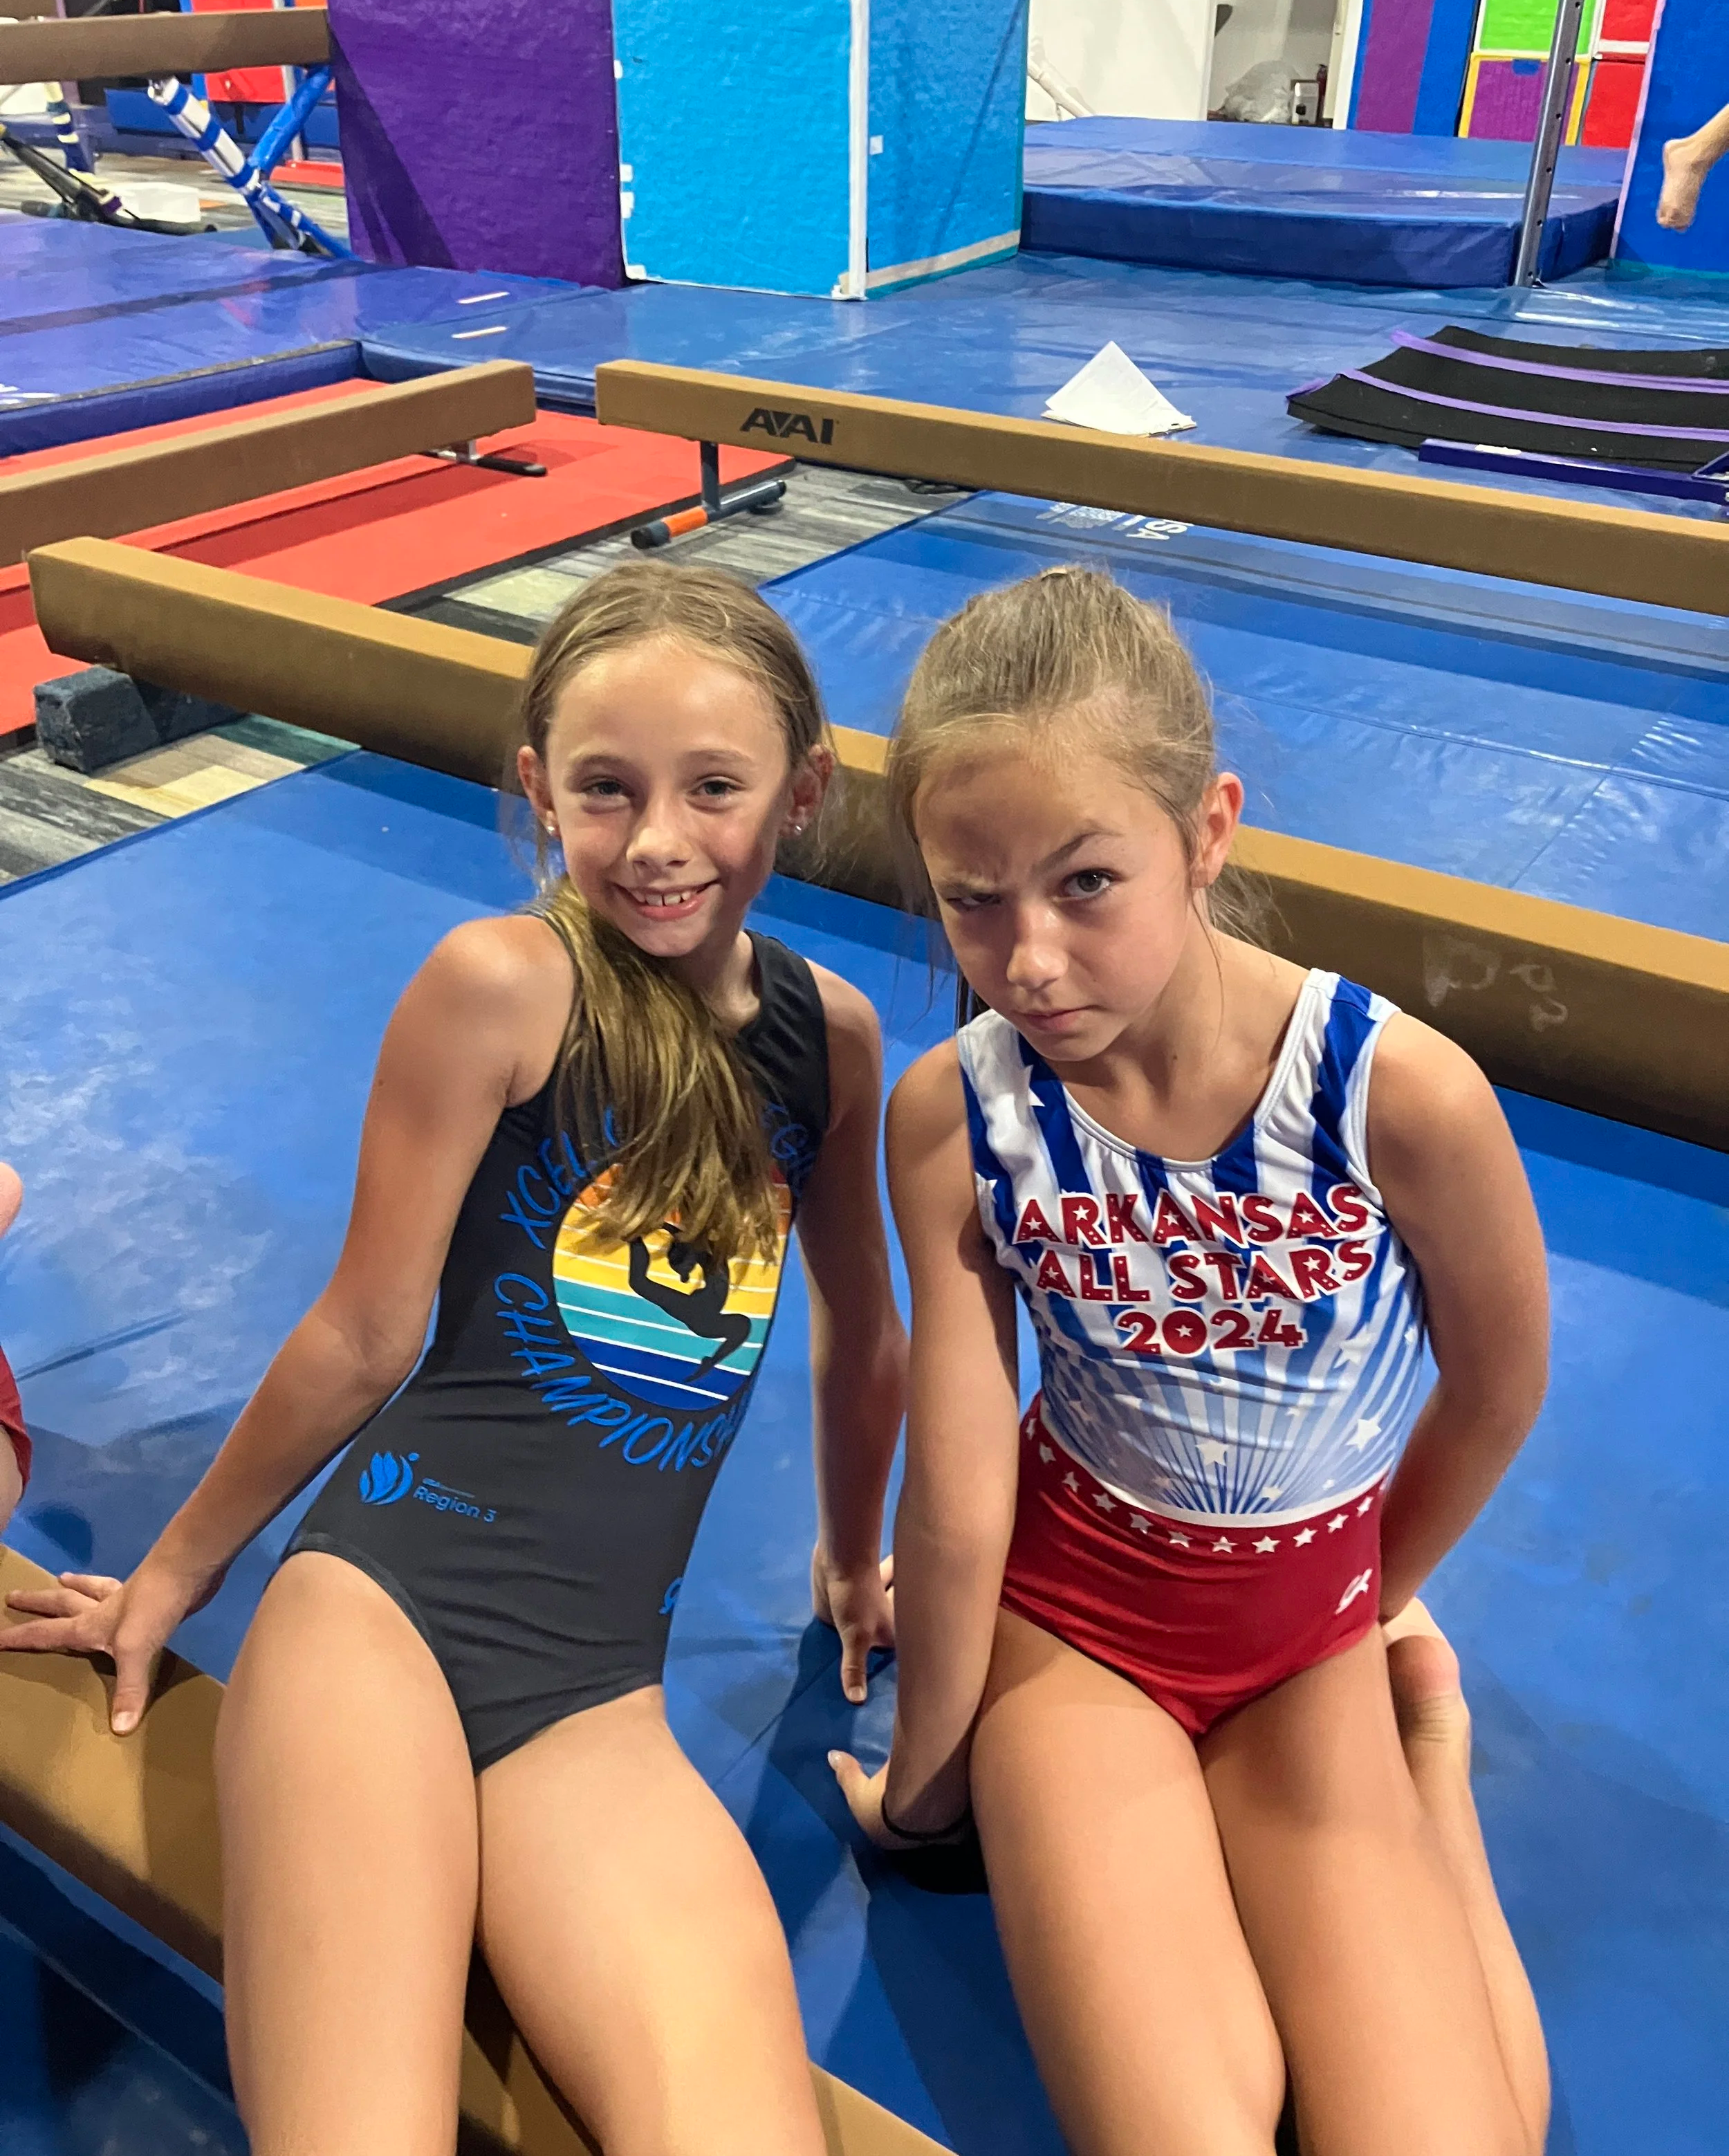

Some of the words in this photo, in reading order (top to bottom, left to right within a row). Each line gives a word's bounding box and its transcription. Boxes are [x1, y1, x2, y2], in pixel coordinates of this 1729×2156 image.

[1126, 519, 1194, 540] SA
[1013, 1182, 1373, 1249] ARKANSAS
[1036, 1248, 1152, 1304] ALL
[1167, 1240, 1376, 1303] STARS
[1116, 1308, 1306, 1357] 2024
[413, 1486, 481, 1518] Region
